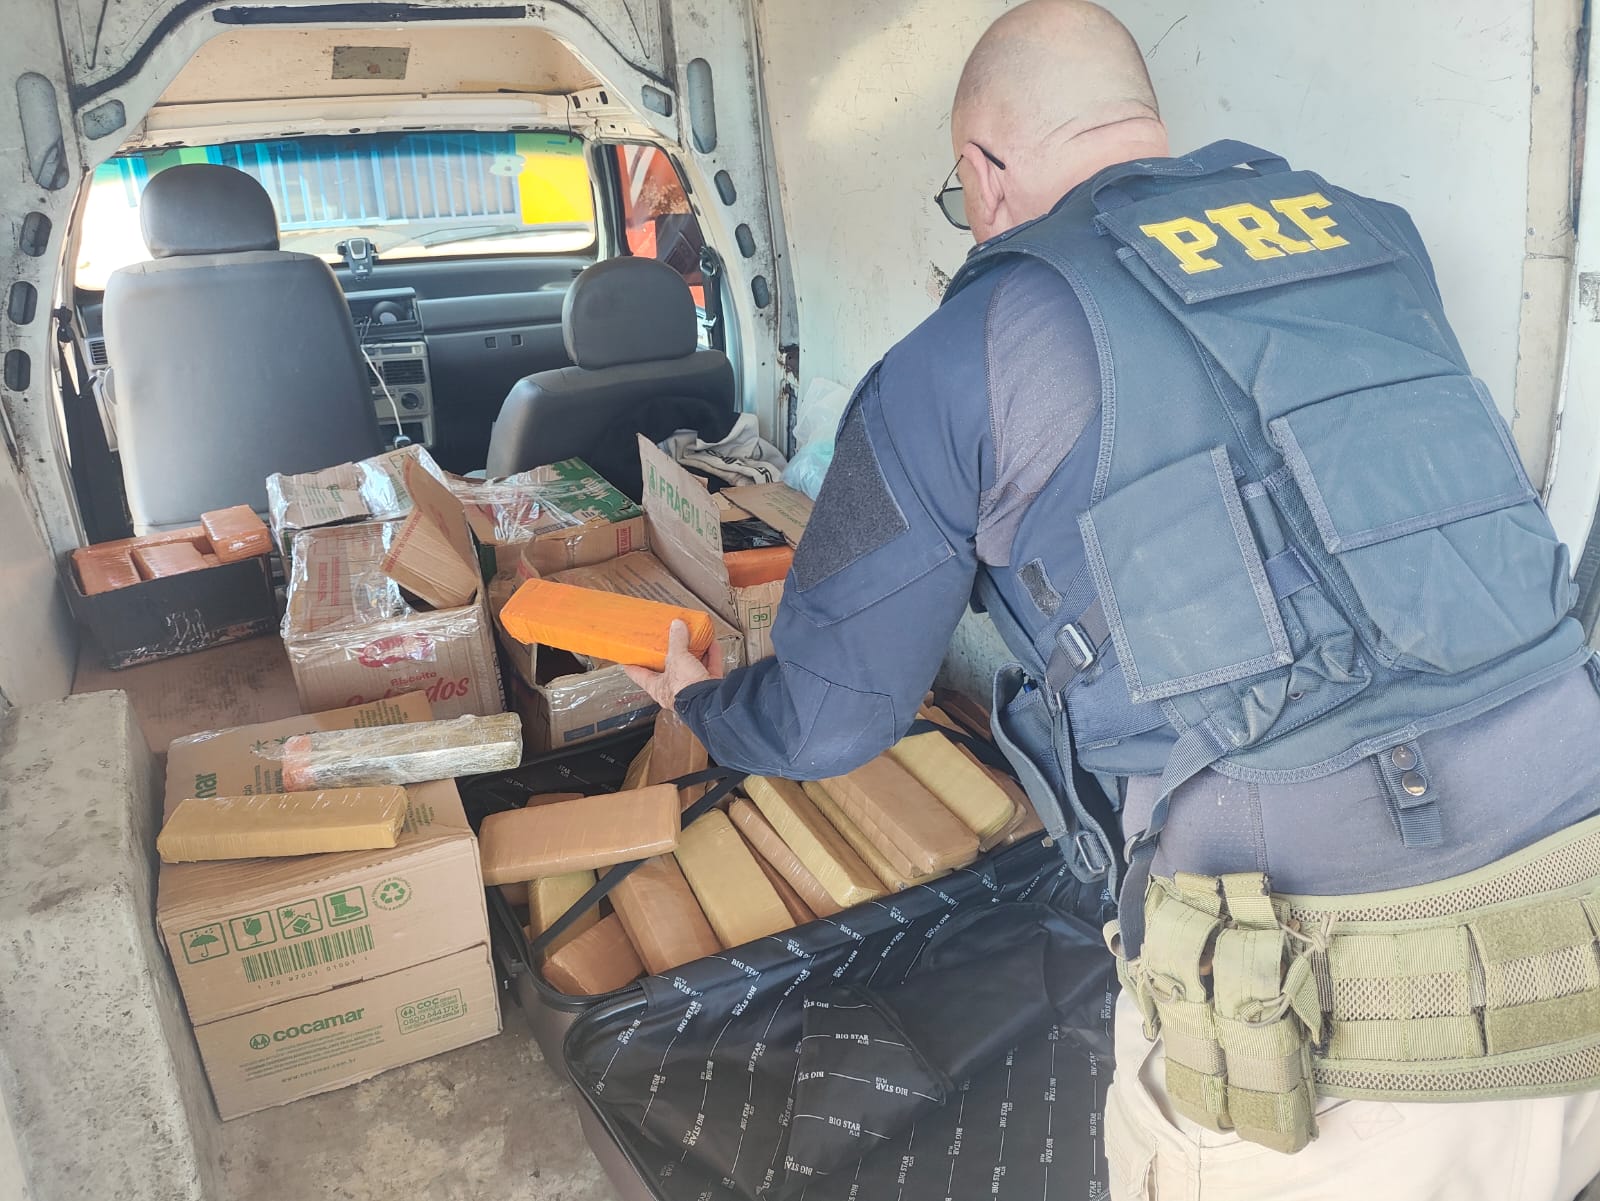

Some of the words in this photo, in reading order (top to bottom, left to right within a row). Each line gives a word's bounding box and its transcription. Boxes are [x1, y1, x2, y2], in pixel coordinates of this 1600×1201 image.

[1140, 192, 1350, 275] PRF
[659, 475, 704, 536] FRÁGIL
[753, 613, 768, 622] GG
[840, 924, 852, 936] BIG
[787, 943, 804, 958] STAR
[881, 946, 891, 958] BIG
[731, 958, 745, 971] BIG
[673, 979, 691, 997] STAR
[747, 985, 757, 1000] BIG
[416, 997, 440, 1010] COC
[677, 1017, 689, 1033] BIG
[686, 1000, 698, 1019] STAR
[272, 1007, 365, 1042] cocamar
[621, 1027, 637, 1045] STAR
[850, 1033, 869, 1041] STAR
[810, 1071, 824, 1080] BIG
[875, 1082, 894, 1093] STAR
[895, 1086, 908, 1096] BIG
[1001, 1102, 1009, 1117] STAR
[829, 1116, 841, 1127] BIG
[843, 1118, 861, 1132] STAR
[688, 1125, 700, 1147] STAR
[955, 1127, 963, 1140] BIG
[953, 1140, 962, 1156] STAR
[800, 1165, 813, 1176] BIG
[900, 1155, 909, 1172] STAR
[766, 1168, 774, 1182] BIG
[897, 1171, 906, 1184] BIG
[993, 1167, 1001, 1182] STAR
[850, 1183, 859, 1196] BIG
[992, 1181, 1000, 1193] BIG
[1089, 1180, 1097, 1198] STAR
